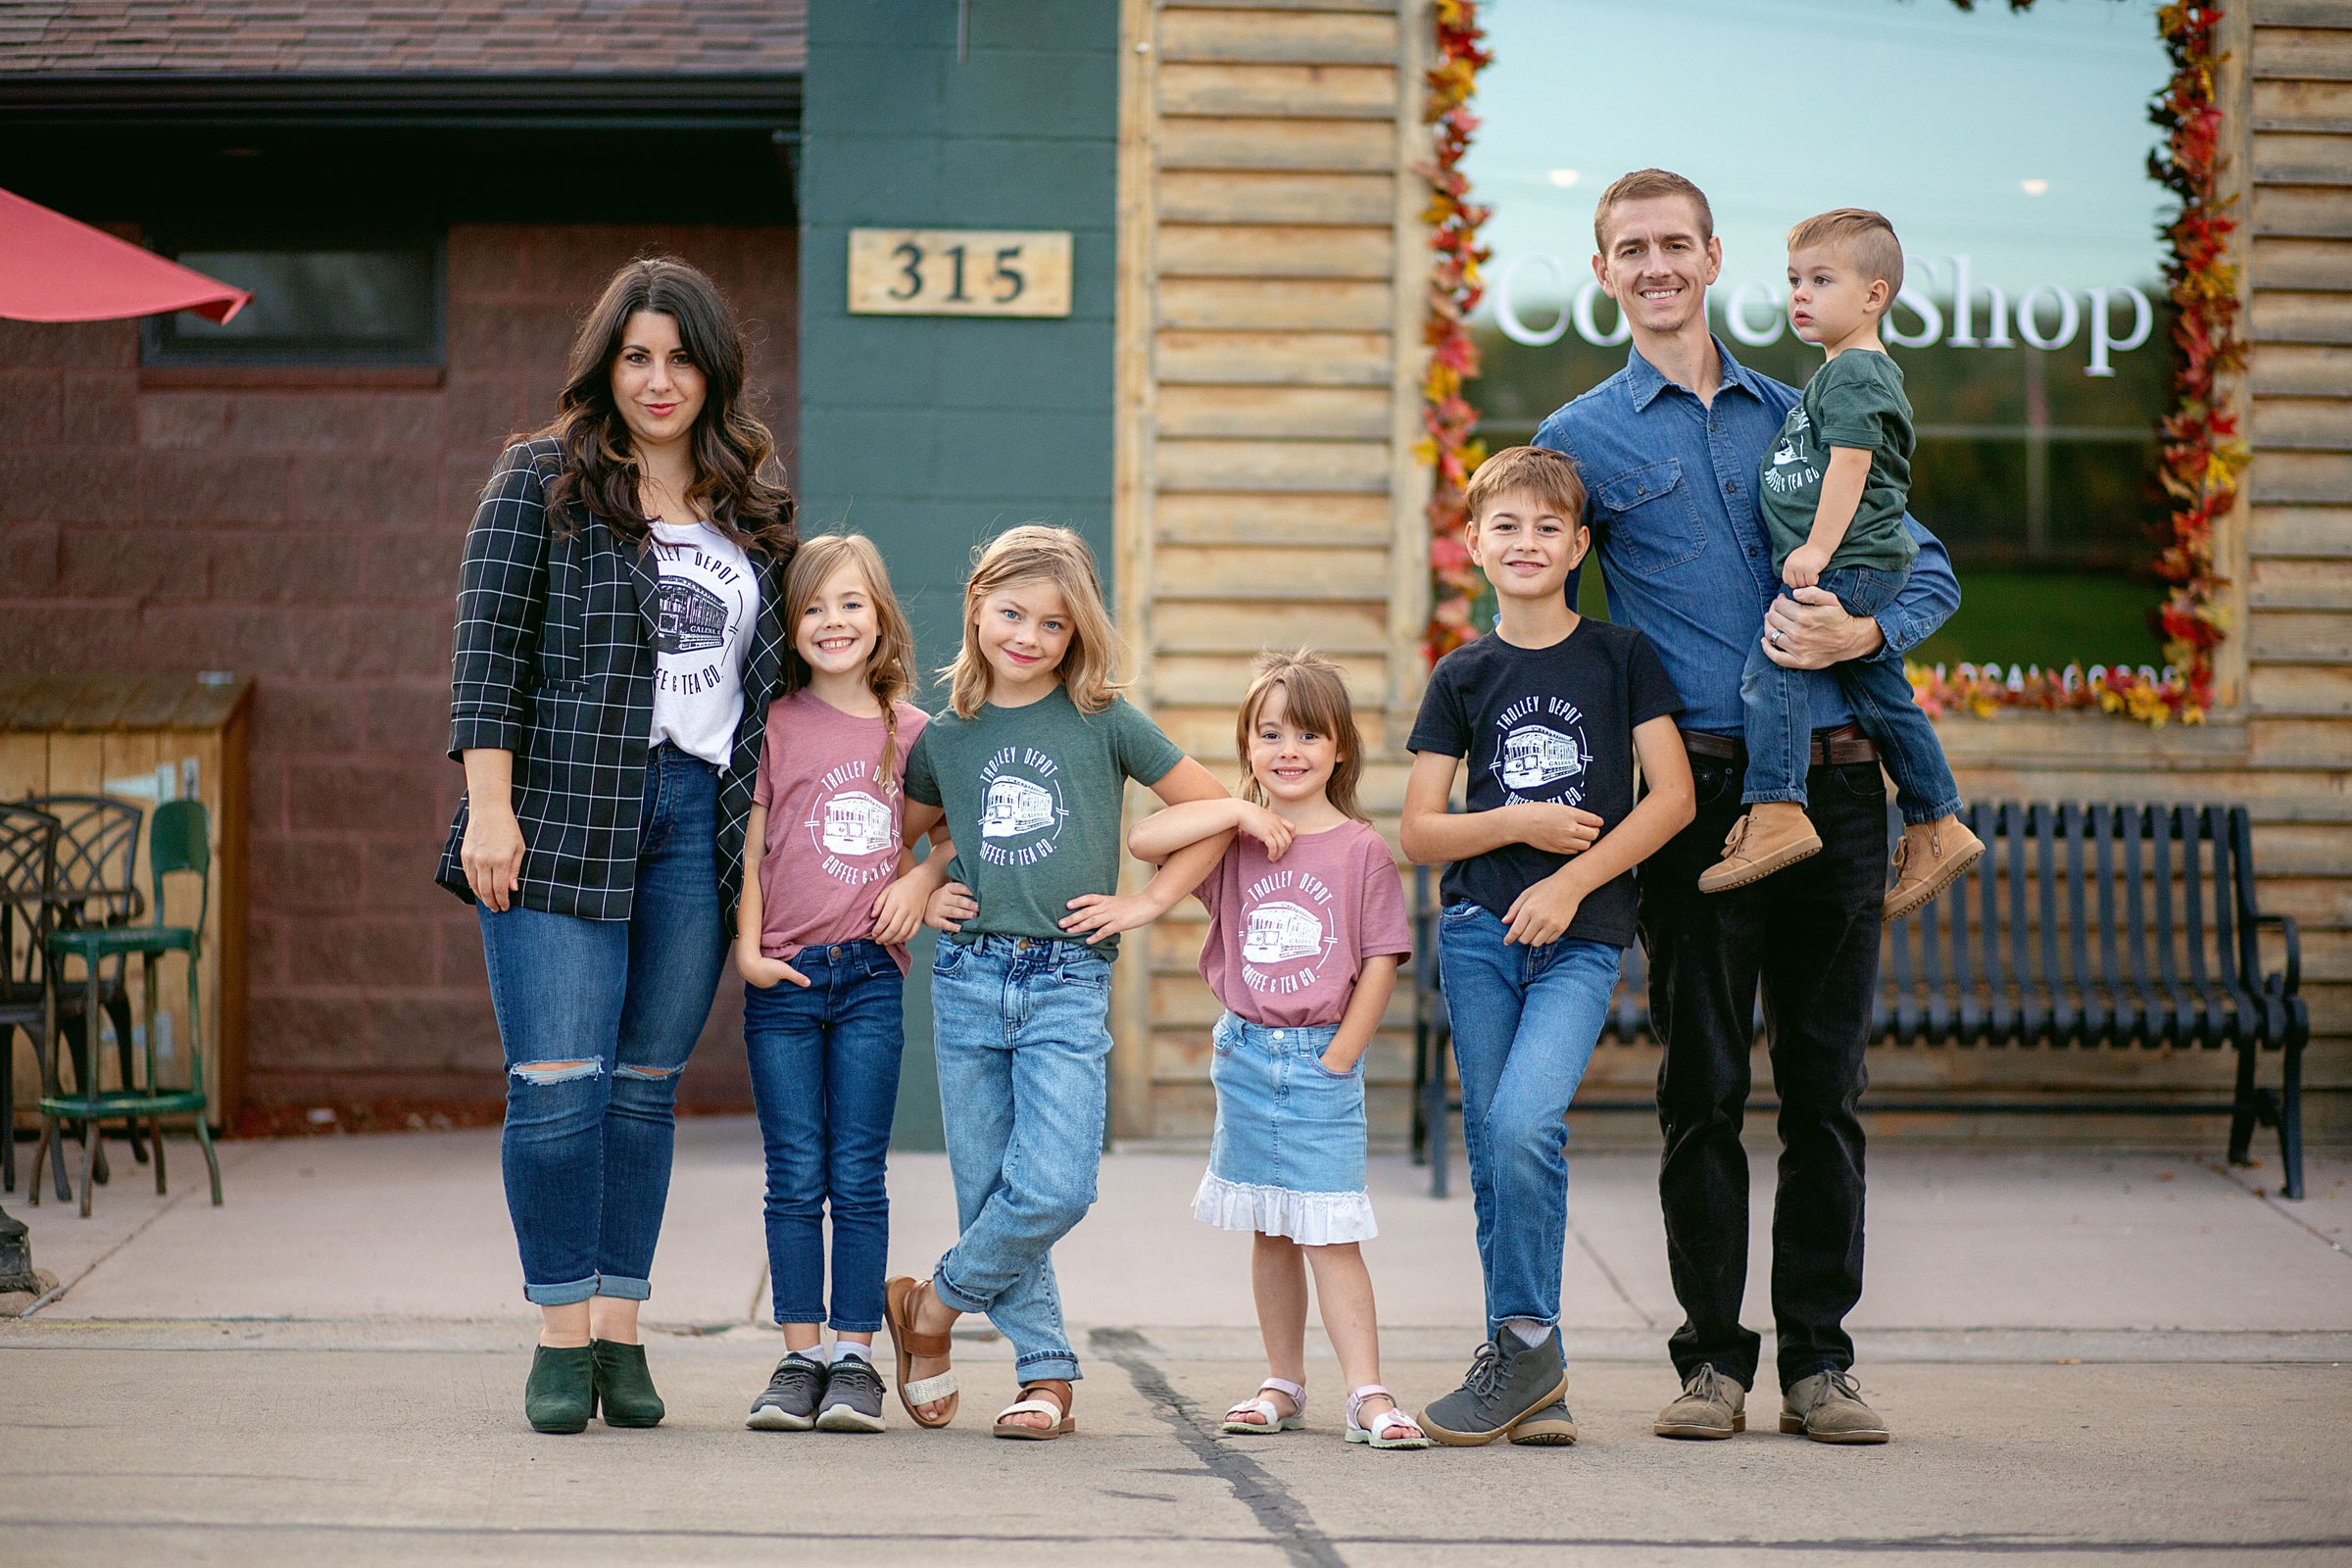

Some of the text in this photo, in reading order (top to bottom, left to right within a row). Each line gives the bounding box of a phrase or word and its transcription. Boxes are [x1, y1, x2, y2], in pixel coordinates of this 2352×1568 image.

[888, 241, 1025, 303] 315
[1881, 252, 2154, 377] Shop
[1788, 472, 1803, 491] TEA
[695, 552, 741, 585] DEPOT
[682, 673, 702, 695] TEA
[703, 664, 724, 688] CO.
[1496, 696, 1583, 730] TROLLEY DEPOT
[821, 760, 865, 792] TROLLEY
[980, 747, 1058, 783] TROLLEY DEPOT
[1565, 787, 1586, 806] CO.
[1018, 846, 1038, 865] TEA
[1036, 838, 1057, 858] CO.
[822, 855, 859, 885] COFFEE
[1247, 869, 1333, 906] TROLLEY DEPOT
[1280, 974, 1298, 994] TEA
[1299, 966, 1320, 987] CO.
